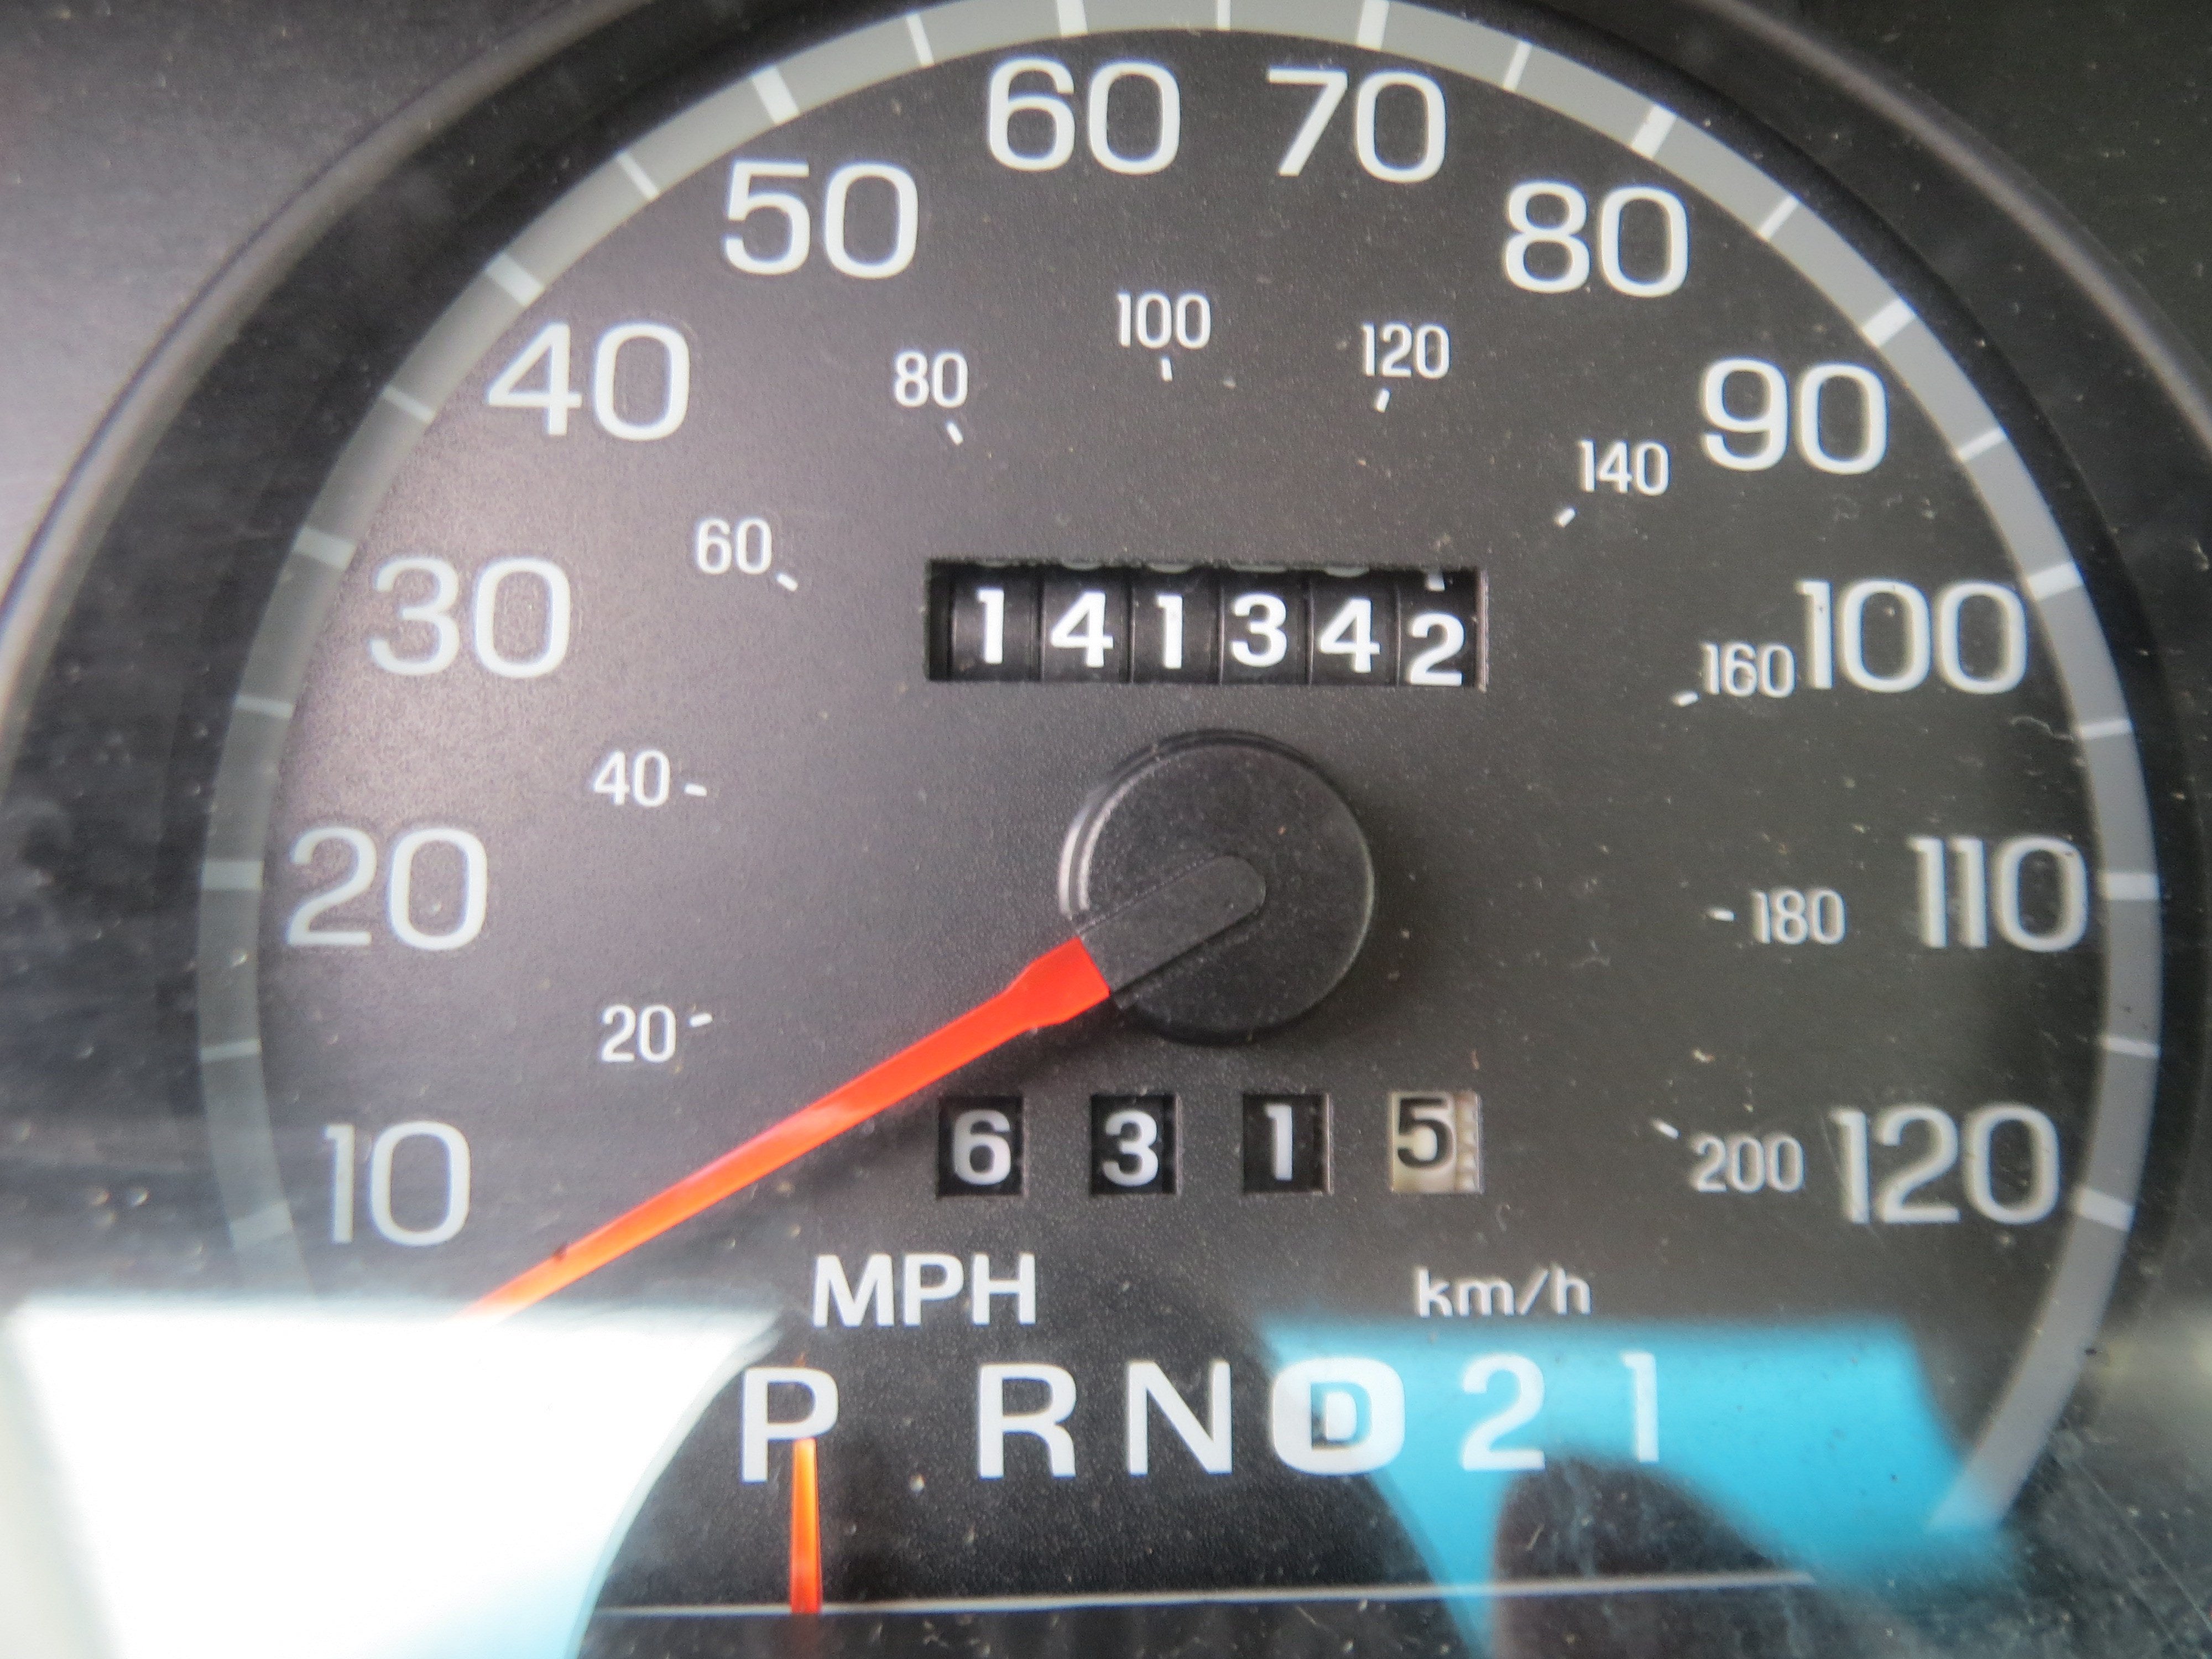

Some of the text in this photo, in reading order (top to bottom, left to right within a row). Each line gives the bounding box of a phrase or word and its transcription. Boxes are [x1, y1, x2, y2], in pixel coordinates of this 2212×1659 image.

[987, 57, 1181, 174] 60
[1267, 66, 1447, 181] 70
[723, 160, 919, 278] 50
[1503, 181, 1689, 297] 80
[1118, 293, 1211, 348] 100
[1363, 324, 1449, 378] 120
[487, 322, 689, 440] 40
[894, 351, 967, 408] 80
[1701, 357, 1887, 474] 90
[1579, 440, 1668, 495] 140
[696, 518, 771, 573] 60
[372, 557, 571, 678] 30
[977, 587, 1465, 687] 141342
[1703, 643, 1794, 697] 160
[1798, 579, 2029, 693] 100
[593, 750, 670, 806] 40
[284, 825, 488, 951] 20
[1752, 889, 1844, 944] 180
[1906, 834, 2089, 952] 110
[602, 1005, 675, 1062] 20
[324, 1119, 471, 1247] 10
[1691, 1134, 1803, 1192] 200
[1829, 1105, 2060, 1224] 120
[812, 1254, 1035, 1327] MPH
[1415, 1268, 1590, 1317] km/h
[741, 1367, 838, 1484] P
[978, 1363, 1076, 1478] R
[1126, 1360, 1232, 1474] N
[1462, 1353, 1545, 1470] 2
[1621, 1350, 1658, 1462] 1
